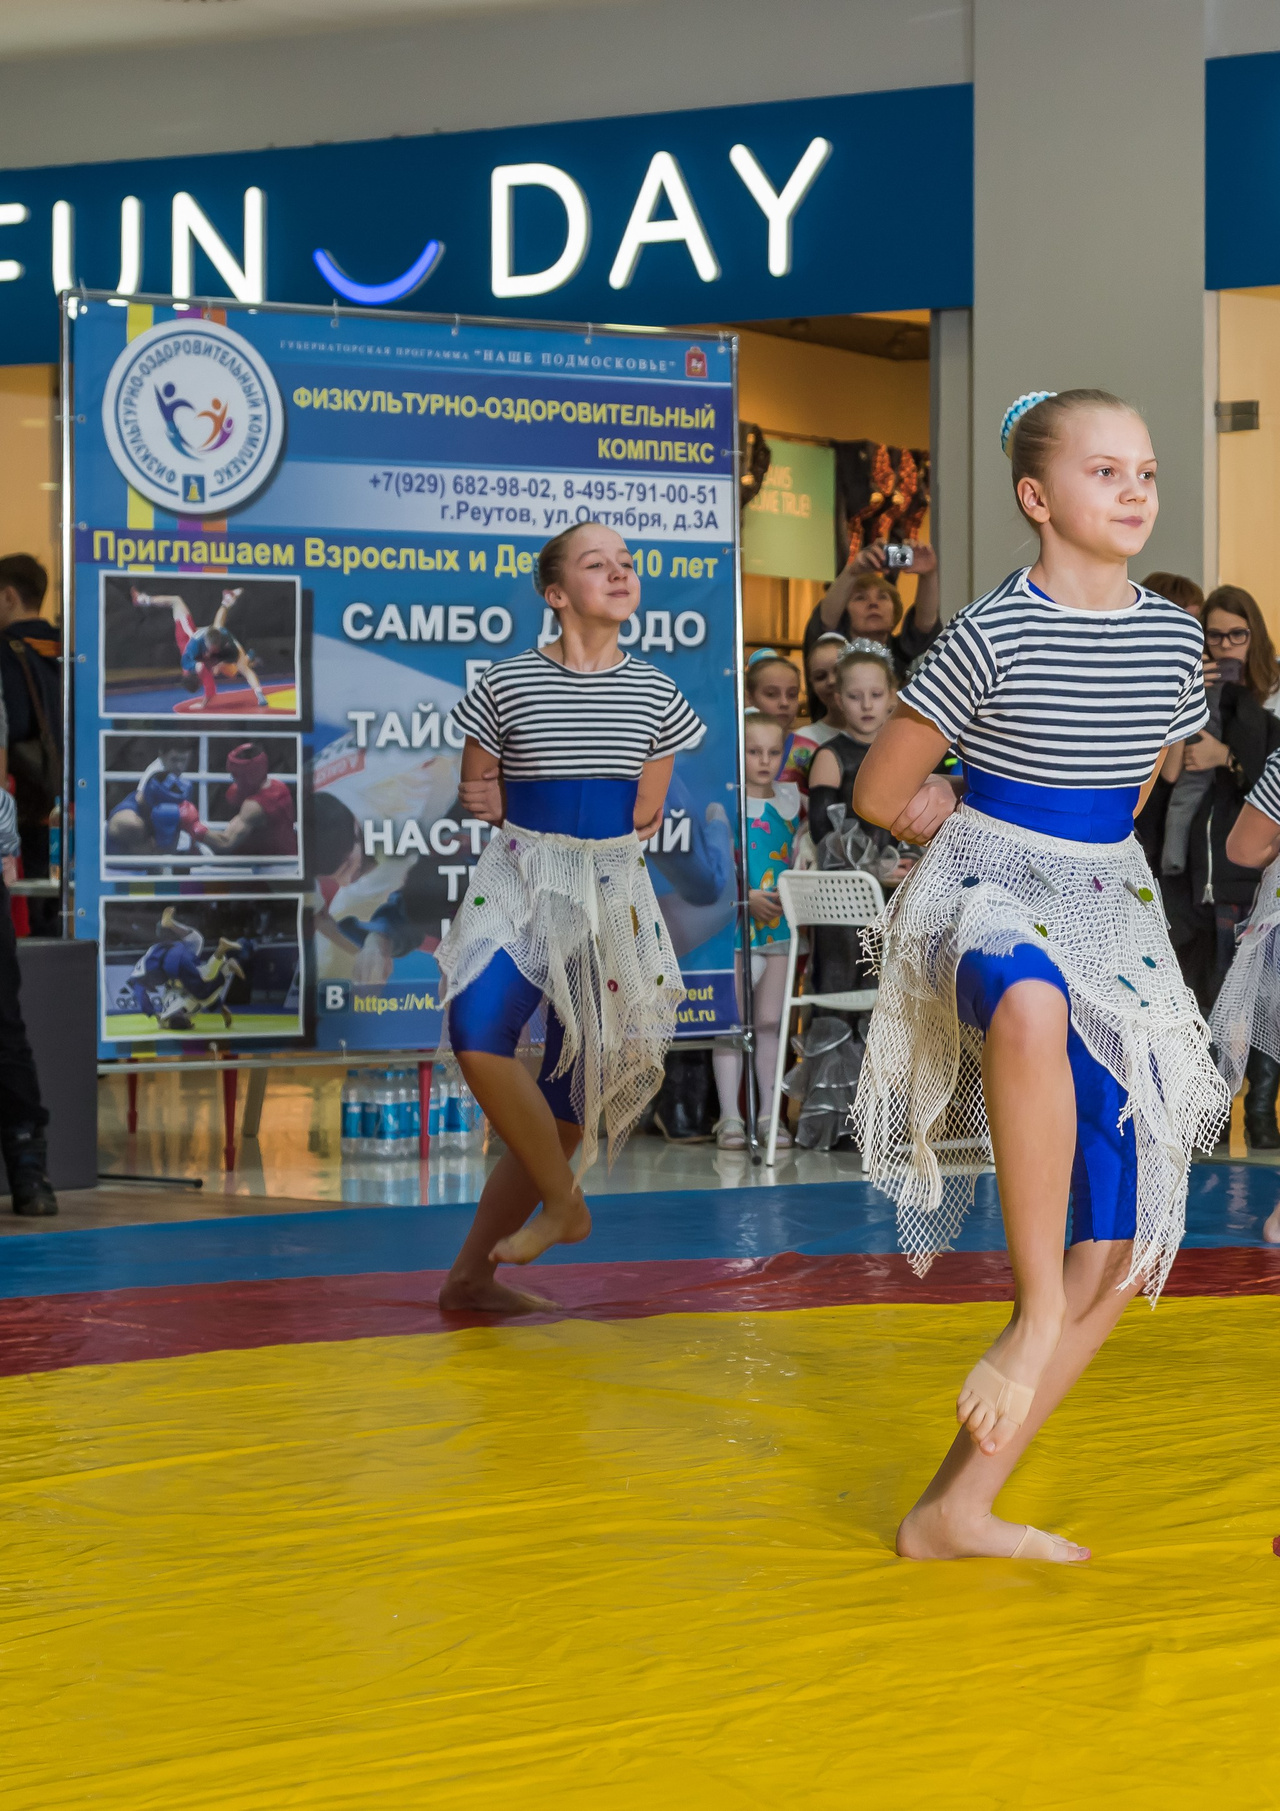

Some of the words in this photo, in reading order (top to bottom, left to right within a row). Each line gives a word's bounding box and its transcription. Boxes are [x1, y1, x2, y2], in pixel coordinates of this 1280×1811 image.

[490, 136, 834, 300] DAY
[395, 346, 470, 361] ПРОГРАММА
[292, 386, 717, 430] ФИЗКУЛЬТУРНО-ОЗДОРОВИТЕЛЬНЫЙ
[213, 412, 263, 485] КОМПЛЕКС
[597, 437, 716, 465] КОМПЛЕКС
[368, 471, 447, 497] +7(929)
[452, 474, 557, 502] 682-98-02,
[563, 480, 718, 505] 8-495-791-00-51
[440, 501, 537, 527] г.Реутов,
[543, 506, 668, 530] ул.Октября,
[93, 530, 295, 568] Приглашаем
[304, 537, 460, 576] Взрослых
[470, 552, 487, 573] и
[632, 550, 663, 579] 10
[670, 555, 719, 580] лет
[342, 602, 514, 645] САМБО
